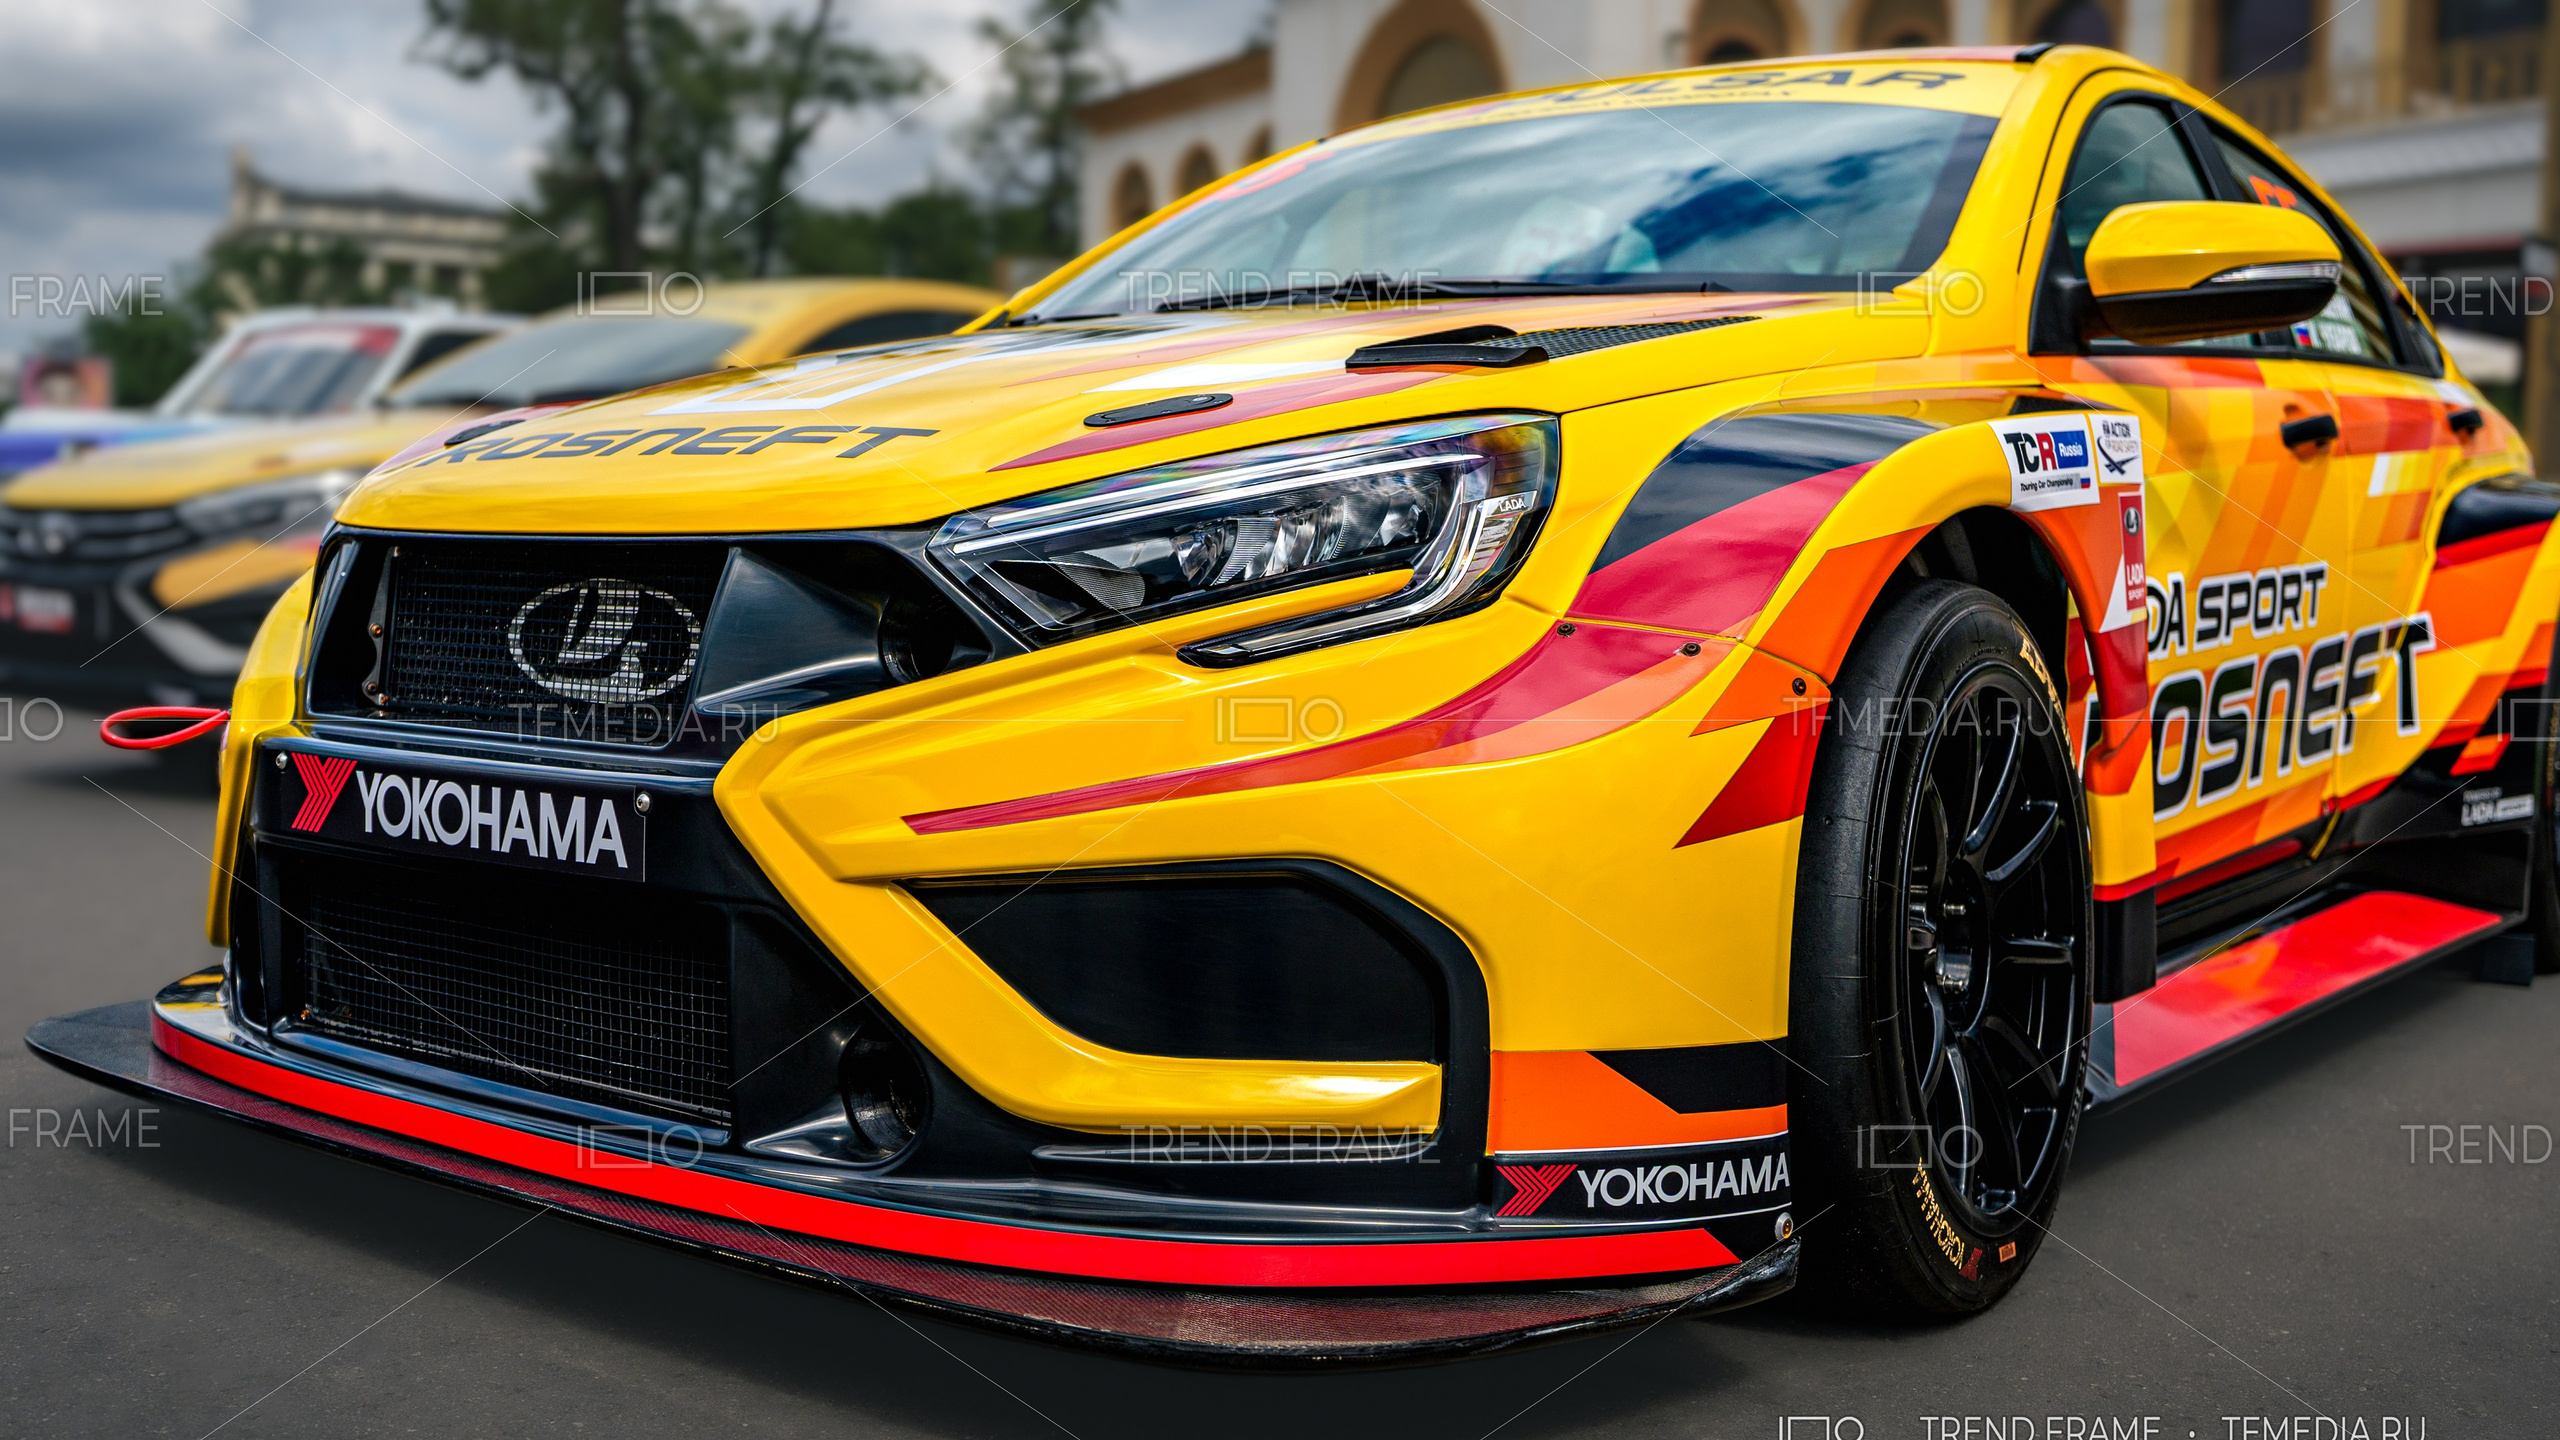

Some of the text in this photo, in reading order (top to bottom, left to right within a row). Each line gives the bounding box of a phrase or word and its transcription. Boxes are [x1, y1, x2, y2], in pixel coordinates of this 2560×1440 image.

[414, 425, 940, 468] ROSNEFT
[2003, 431, 2083, 474] TCR Russia
[1499, 498, 1526, 512] LADA
[2038, 480, 2046, 489] Car
[2127, 563, 2144, 586] LADA
[2194, 561, 2328, 652] SPORT
[2148, 611, 2437, 822] OSNEFT
[355, 770, 628, 869] YOKOHAMA
[1577, 1152, 1791, 1208] YOKOHAMA
